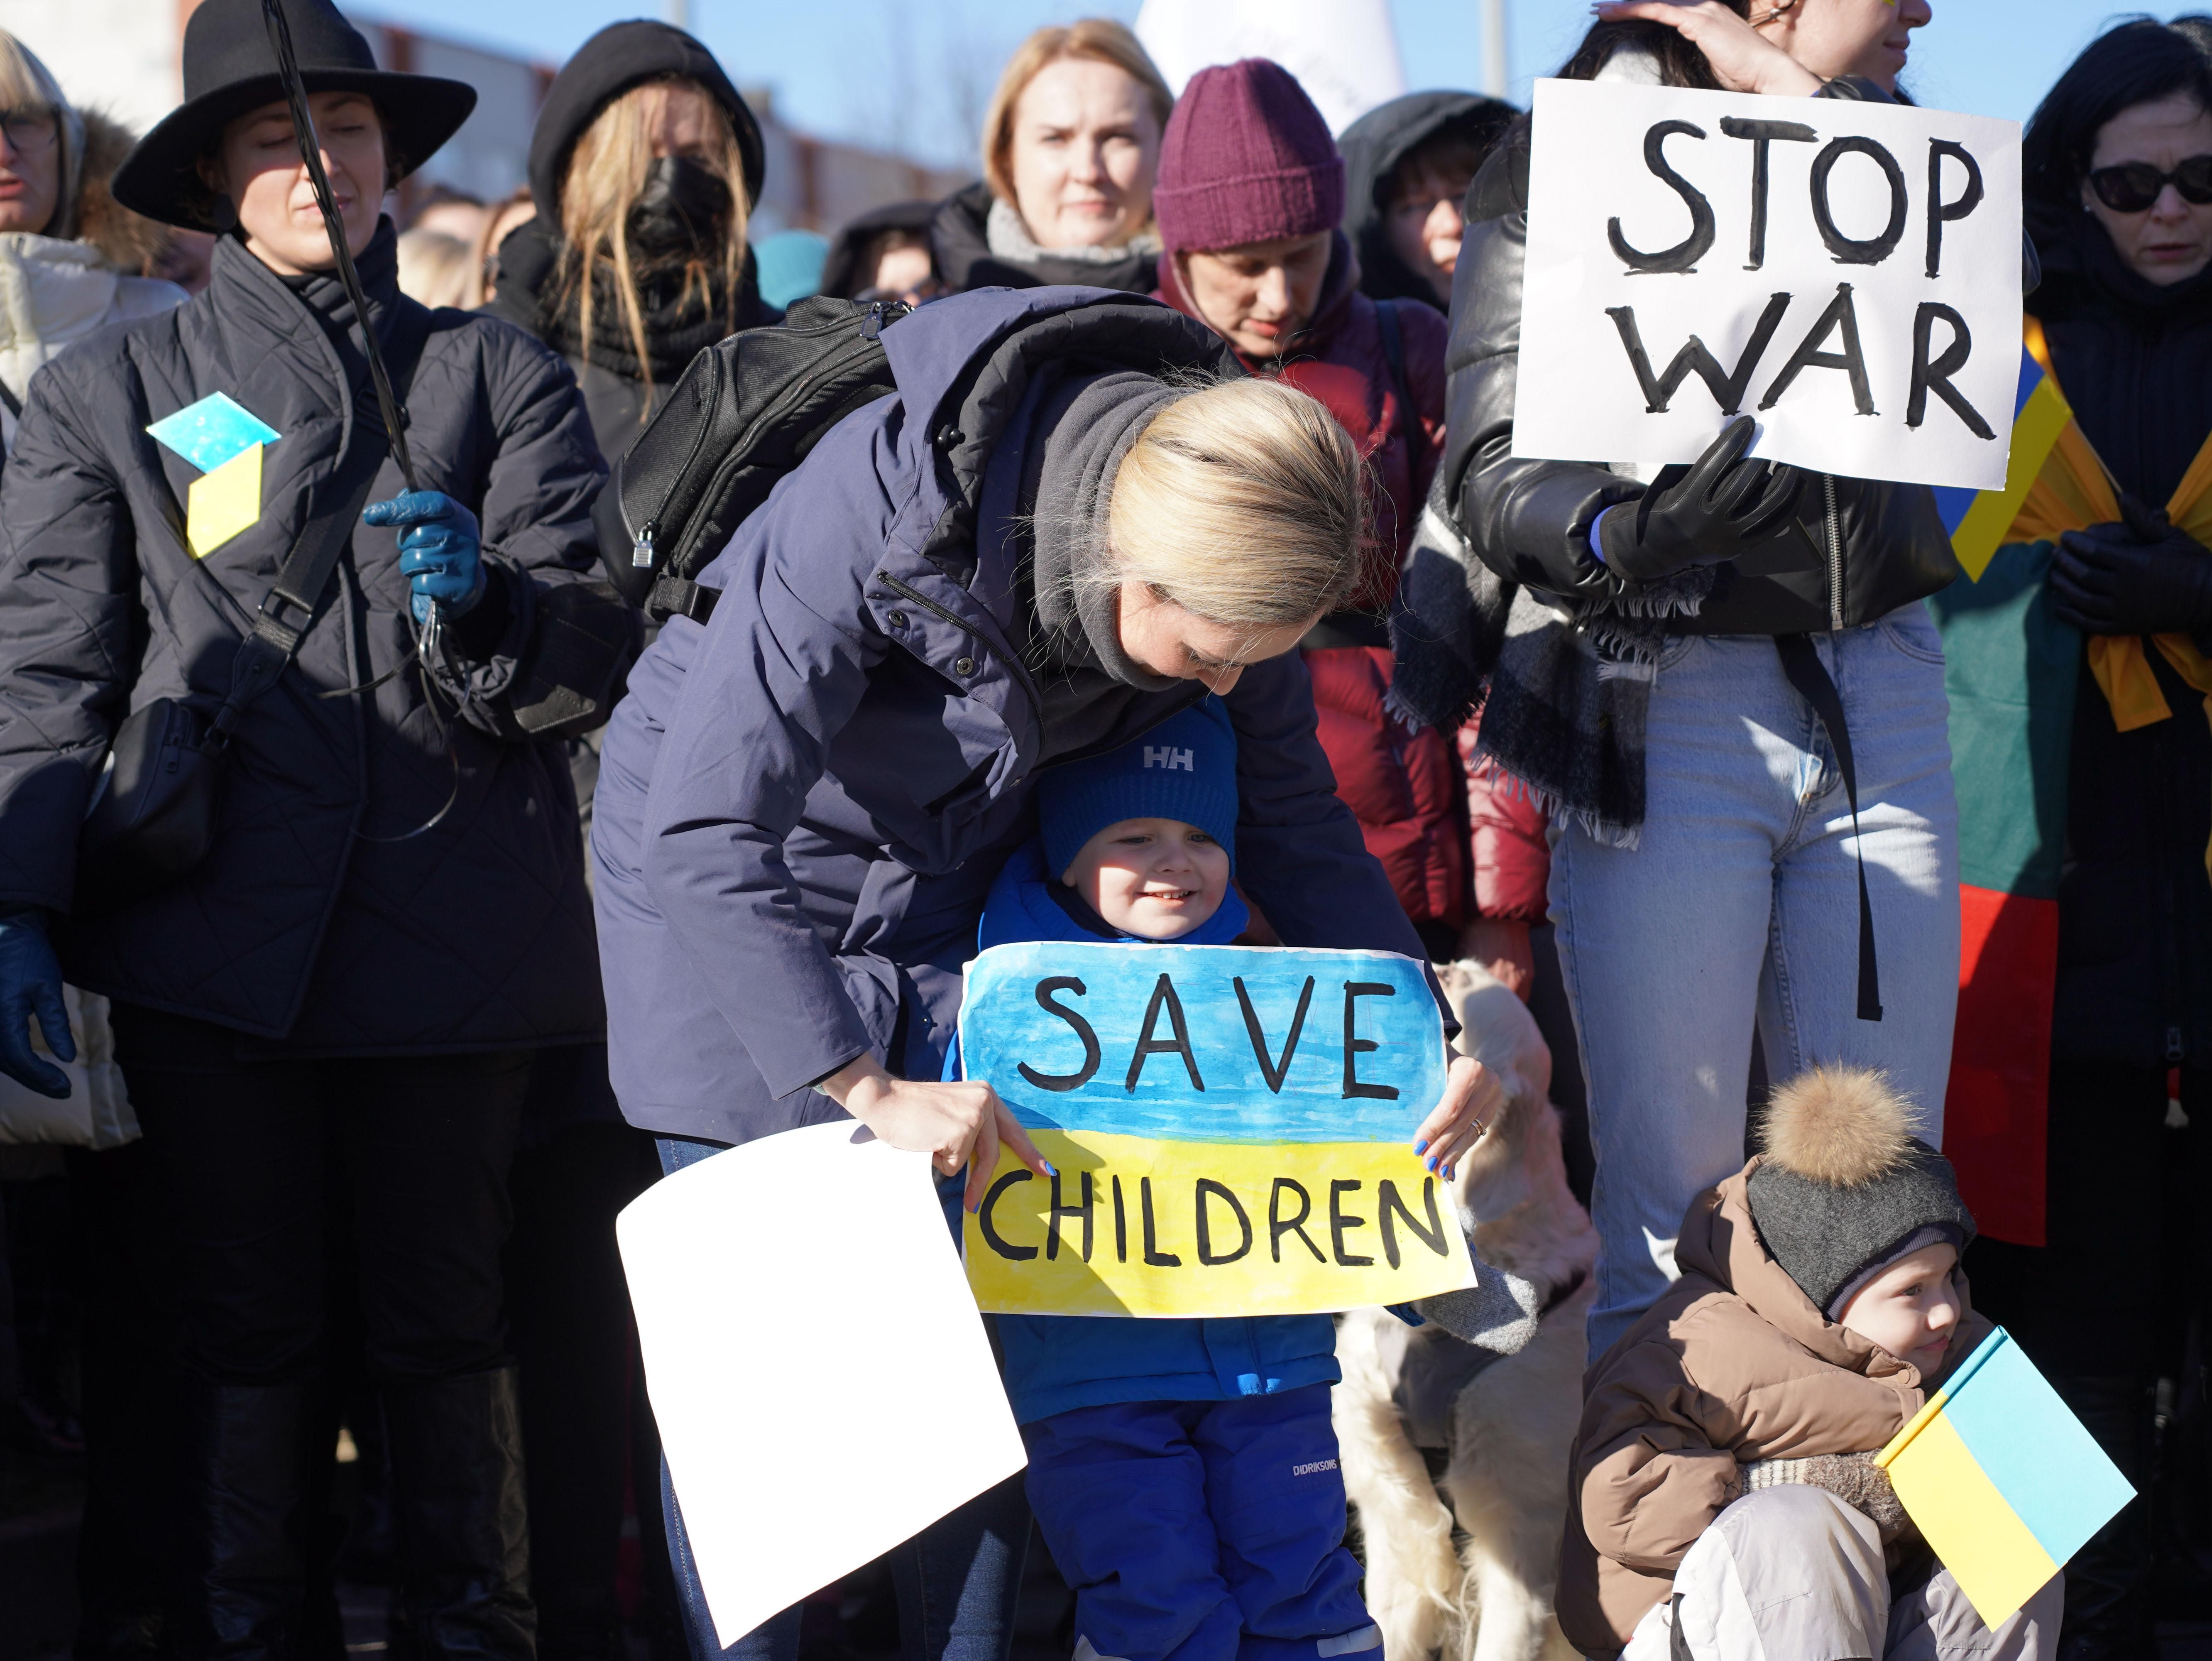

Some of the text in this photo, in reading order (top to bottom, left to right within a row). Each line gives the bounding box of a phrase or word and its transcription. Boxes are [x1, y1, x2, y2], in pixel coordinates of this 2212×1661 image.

[1608, 116, 1985, 280] STOP
[1604, 282, 1998, 441] WAR
[1144, 746, 1194, 771] HH
[1017, 973, 1400, 1100] SAVE
[979, 1169, 1449, 1270] CHILDREN
[1293, 1459, 1337, 1476] DIDRIKSONS
